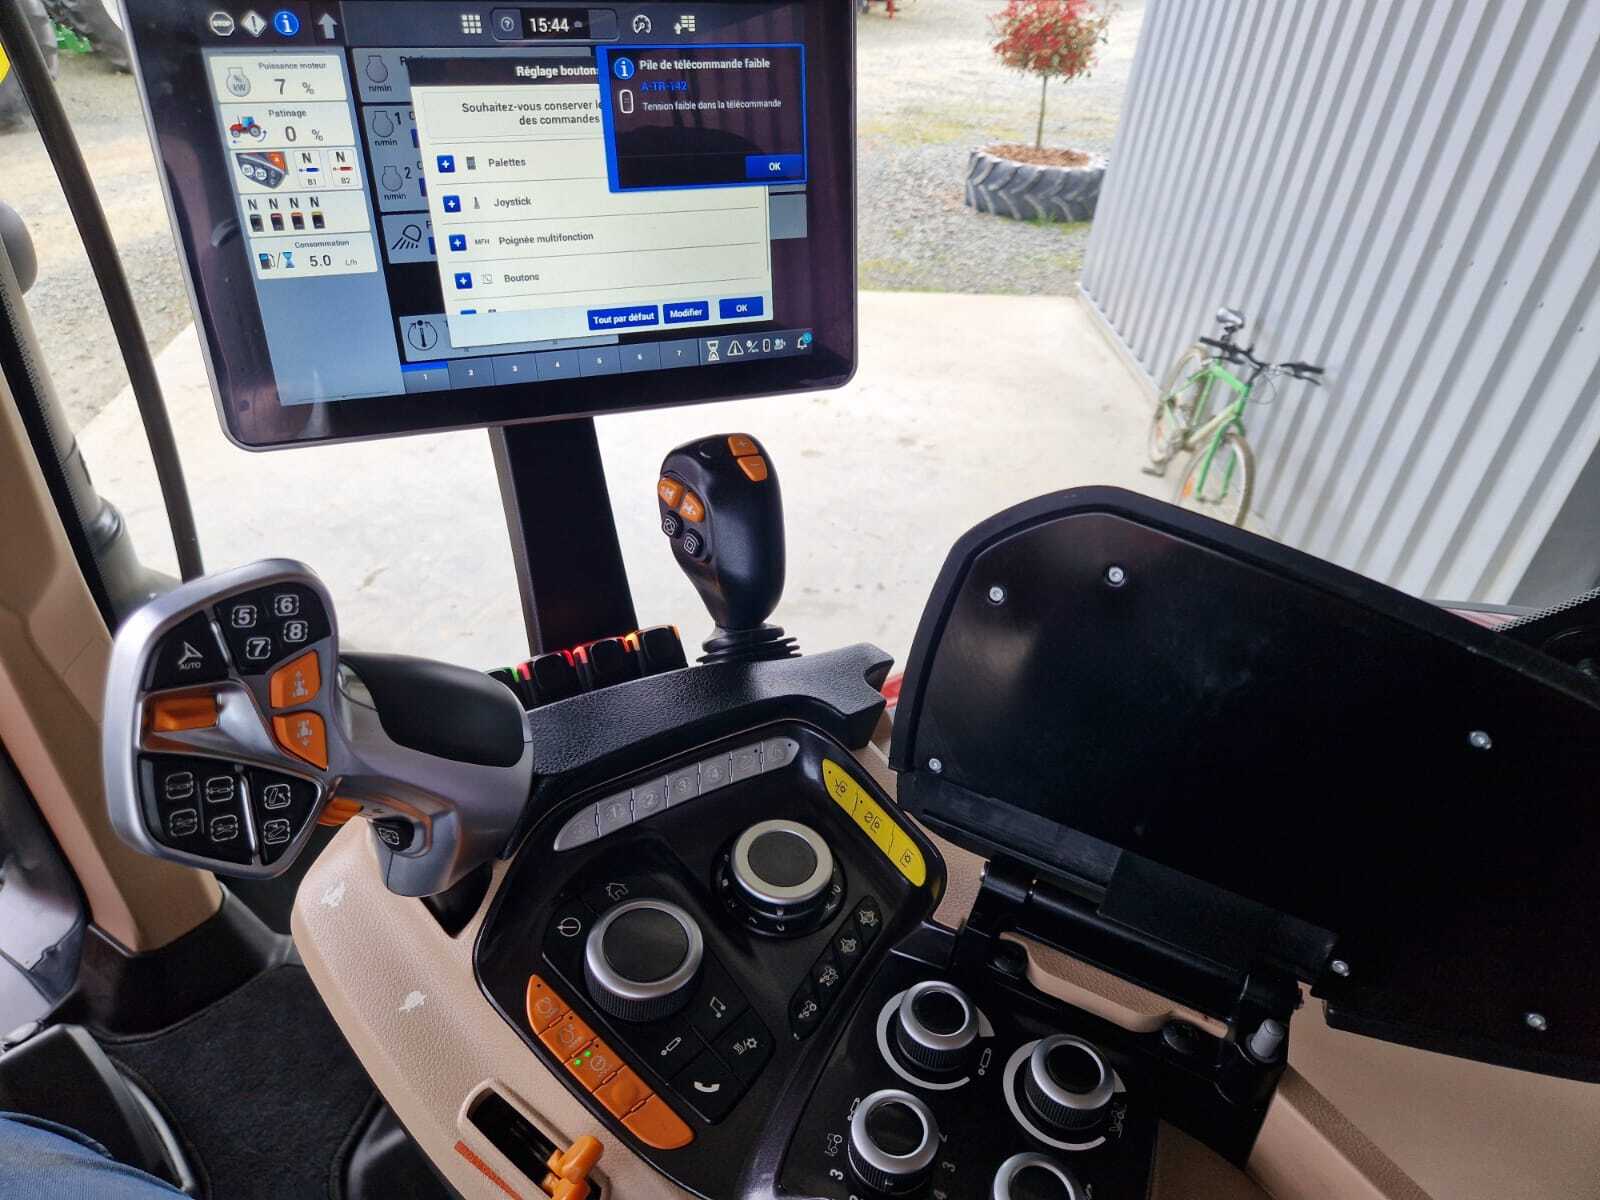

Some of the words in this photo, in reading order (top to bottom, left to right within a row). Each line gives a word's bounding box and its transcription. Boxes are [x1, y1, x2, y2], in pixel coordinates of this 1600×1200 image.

[529, 18, 570, 33] 15:44
[258, 62, 298, 70] Puissance
[639, 59, 658, 70] Pile
[660, 59, 672, 70] de
[674, 58, 743, 70] télécommande
[745, 57, 770, 69] faible
[516, 66, 559, 79] Réglage
[273, 78, 286, 95] 7
[302, 81, 315, 94] %
[461, 101, 542, 113] Souhaitez-vous
[543, 102, 594, 112] conserver
[643, 102, 674, 111] Tension
[675, 101, 696, 111] faible
[698, 101, 717, 110] dans
[717, 100, 725, 109] la
[726, 99, 782, 109] télécommande
[268, 109, 308, 118] Patinage
[519, 114, 538, 125] des
[540, 114, 601, 125] commandes
[285, 126, 296, 142] 0
[311, 128, 324, 141] %
[302, 152, 313, 164] N
[335, 151, 347, 162] N
[488, 157, 527, 168] Palettes
[768, 161, 781, 172] OK
[404, 167, 412, 179] 2
[248, 199, 258, 210] N
[269, 198, 279, 209] N
[289, 197, 300, 208] N
[310, 196, 320, 208] N
[494, 197, 532, 208] Joystick
[294, 239, 350, 249] Consommation
[498, 235, 535, 248] Poignée
[537, 232, 594, 244] multifonction
[309, 254, 332, 267] 5.0
[504, 273, 540, 283] Boutons
[669, 308, 703, 319] Modifier
[735, 303, 748, 313] OK
[593, 315, 612, 325] Tout
[613, 315, 627, 326] par
[629, 311, 655, 322] défaut
[280, 598, 293, 613] 6
[238, 608, 251, 624] 5
[290, 624, 303, 640] 8
[252, 641, 266, 657] 7
[180, 661, 202, 670] AUTO
[829, 1169, 844, 1180] 3
